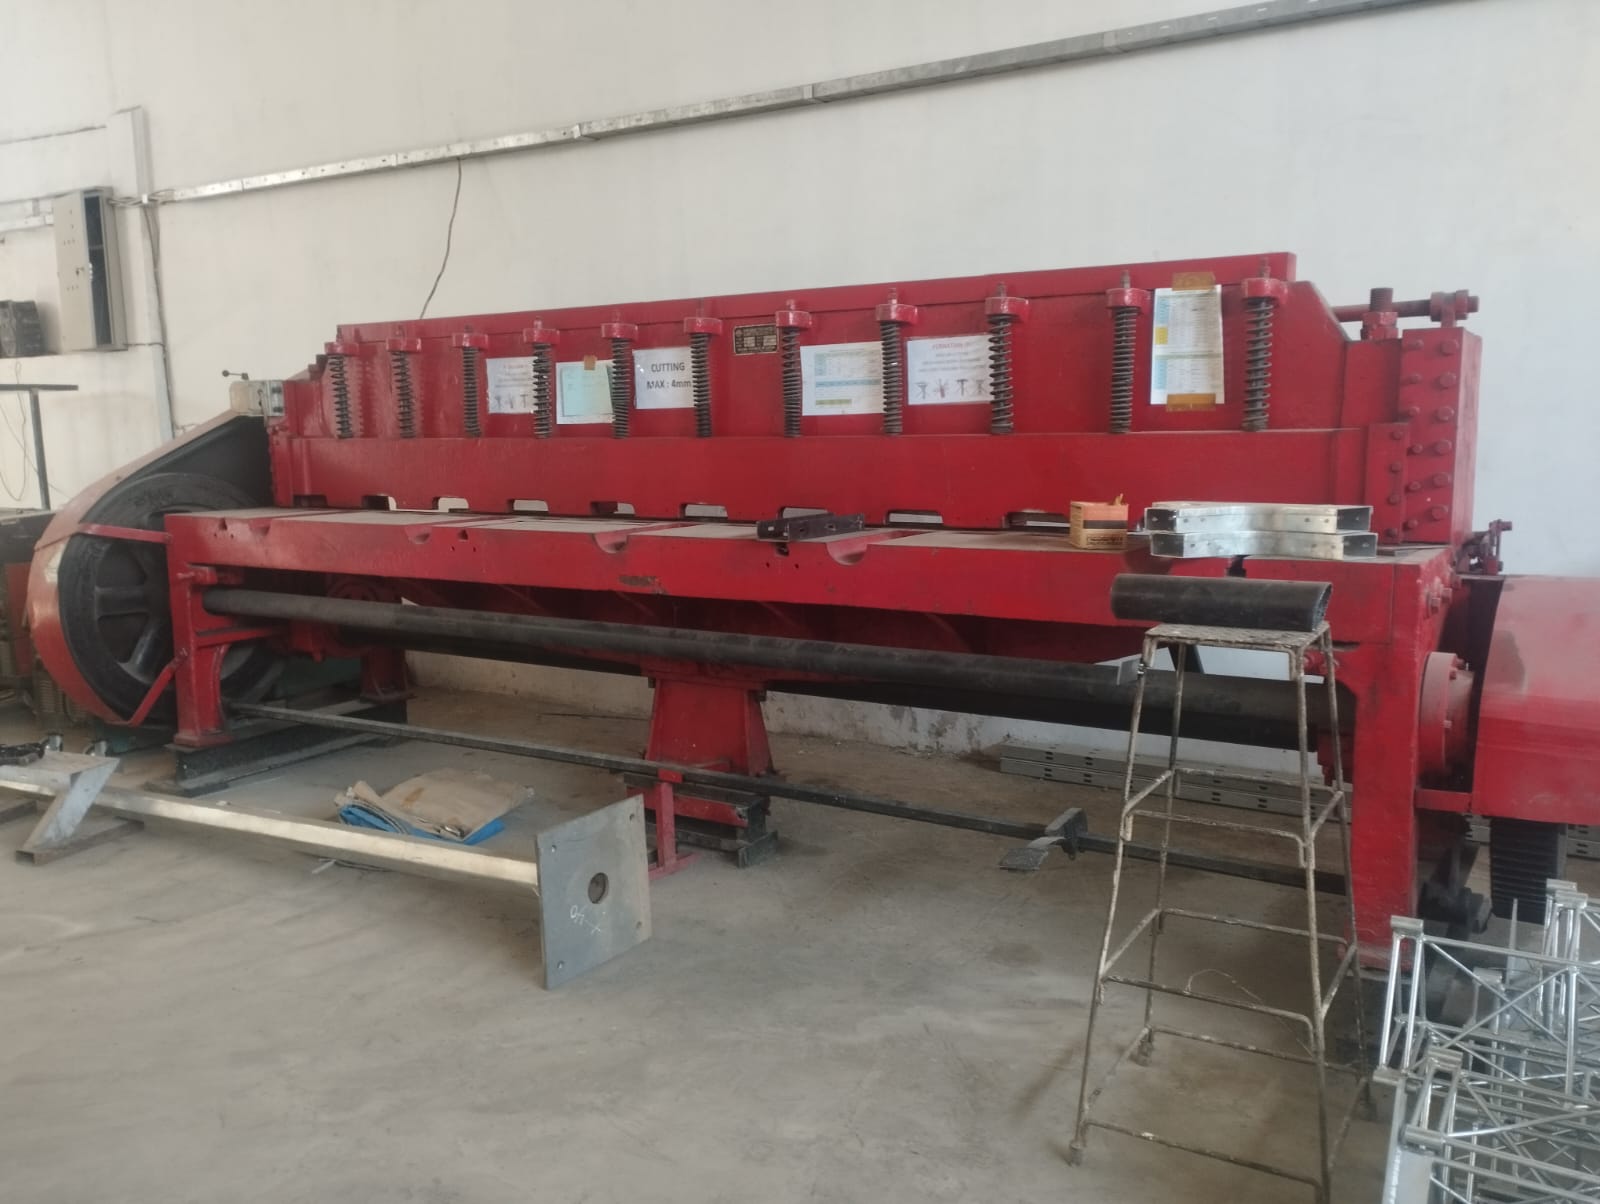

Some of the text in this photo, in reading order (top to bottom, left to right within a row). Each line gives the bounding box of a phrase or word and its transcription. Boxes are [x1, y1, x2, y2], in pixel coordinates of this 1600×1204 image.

[651, 362, 686, 373] CUTTING
[647, 380, 665, 389] MAX
[671, 379, 692, 388] 4mm
